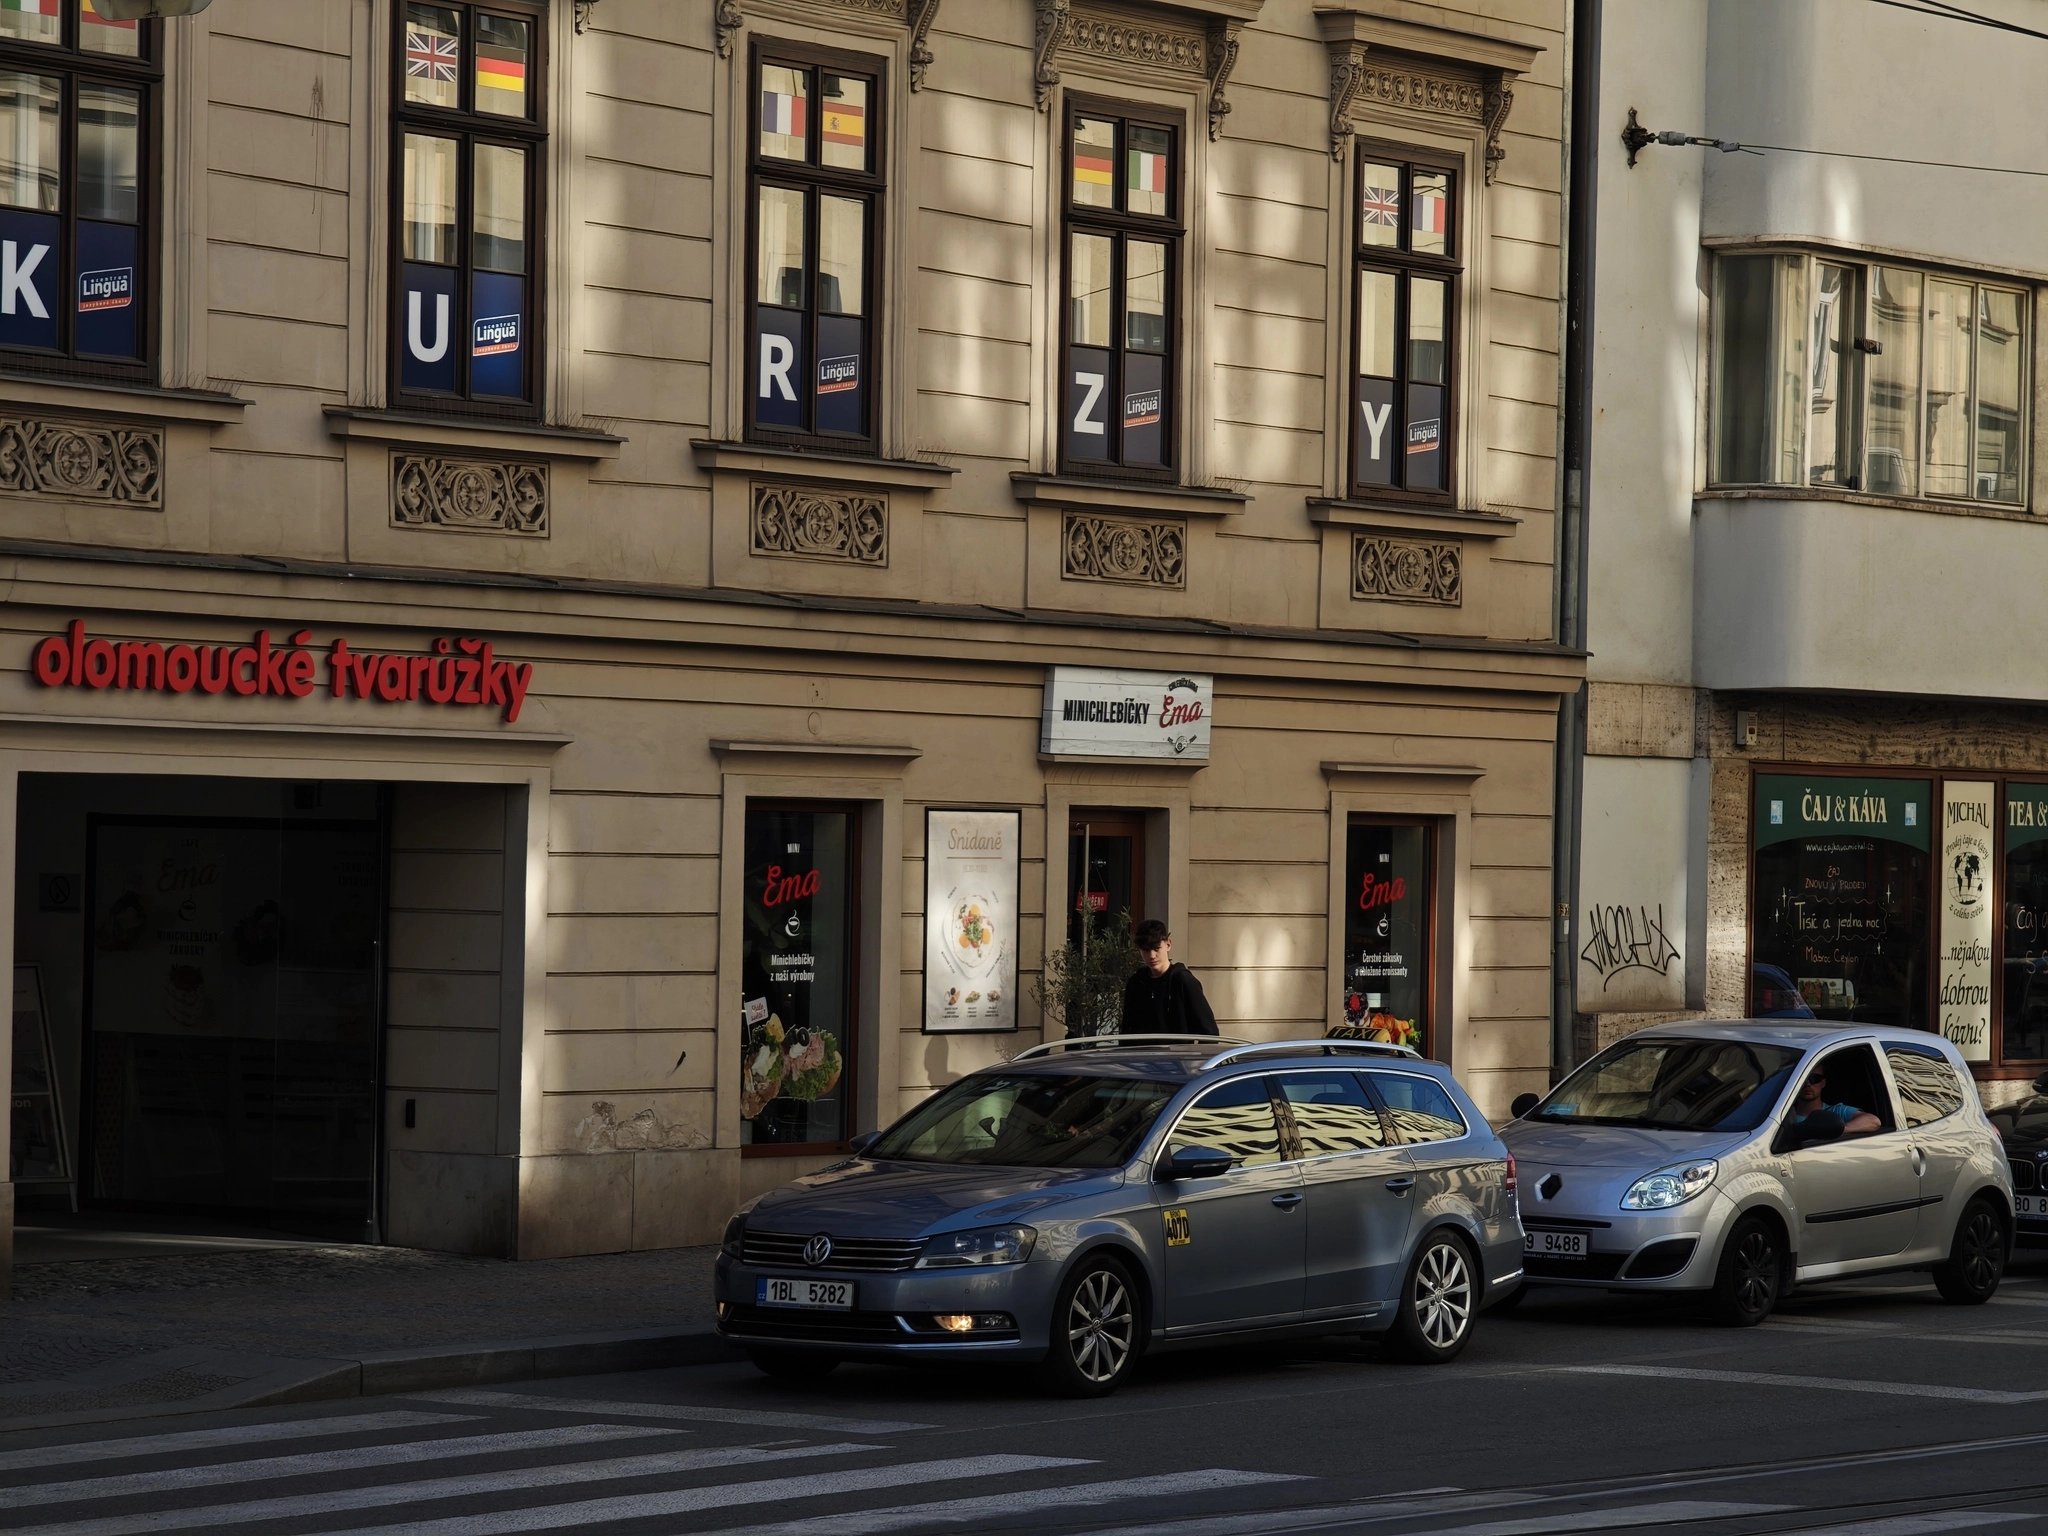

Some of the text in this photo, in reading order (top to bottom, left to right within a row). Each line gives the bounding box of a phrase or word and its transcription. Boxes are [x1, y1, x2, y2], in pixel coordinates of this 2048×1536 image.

[1, 240, 50, 318] K
[83, 279, 128, 297] Lingua
[408, 291, 449, 362] U
[477, 325, 516, 343] Lingua
[760, 333, 797, 401] R
[821, 365, 856, 382] Lingua
[1073, 372, 1104, 434] Z
[1127, 400, 1158, 415] Lingua
[1361, 401, 1392, 460] Y
[1409, 428, 1437, 443] Lingua
[33, 619, 533, 723] olomoucké tvarůžky
[1063, 698, 1150, 724] MINICHLEBÍČKY
[1159, 695, 1203, 728] Ema
[1802, 788, 1887, 823] ČAJ & KÁVA
[1947, 801, 1989, 829] MICHAL
[2008, 801, 2048, 826] TEA &
[948, 828, 1002, 850] Snídaně
[763, 865, 822, 907] Ema
[1360, 871, 1406, 911] Ema
[1822, 917, 1831, 929] a
[1836, 912, 1862, 941] jedna
[1865, 918, 1880, 929] noc
[771, 954, 815, 967] Minichlebíčky
[1362, 950, 1403, 964] Čerstvé zákusky
[770, 969, 815, 983] z naší výrobny
[1355, 966, 1408, 978] a obložené croissanty
[1940, 974, 1988, 1005] dobrou
[1333, 1027, 1378, 1041] TAXI
[1943, 1014, 1986, 1045] kávu?
[1167, 1216, 1190, 1240] 407D
[1545, 1235, 1581, 1252] 9488
[771, 1282, 846, 1305] 1BL 5282
